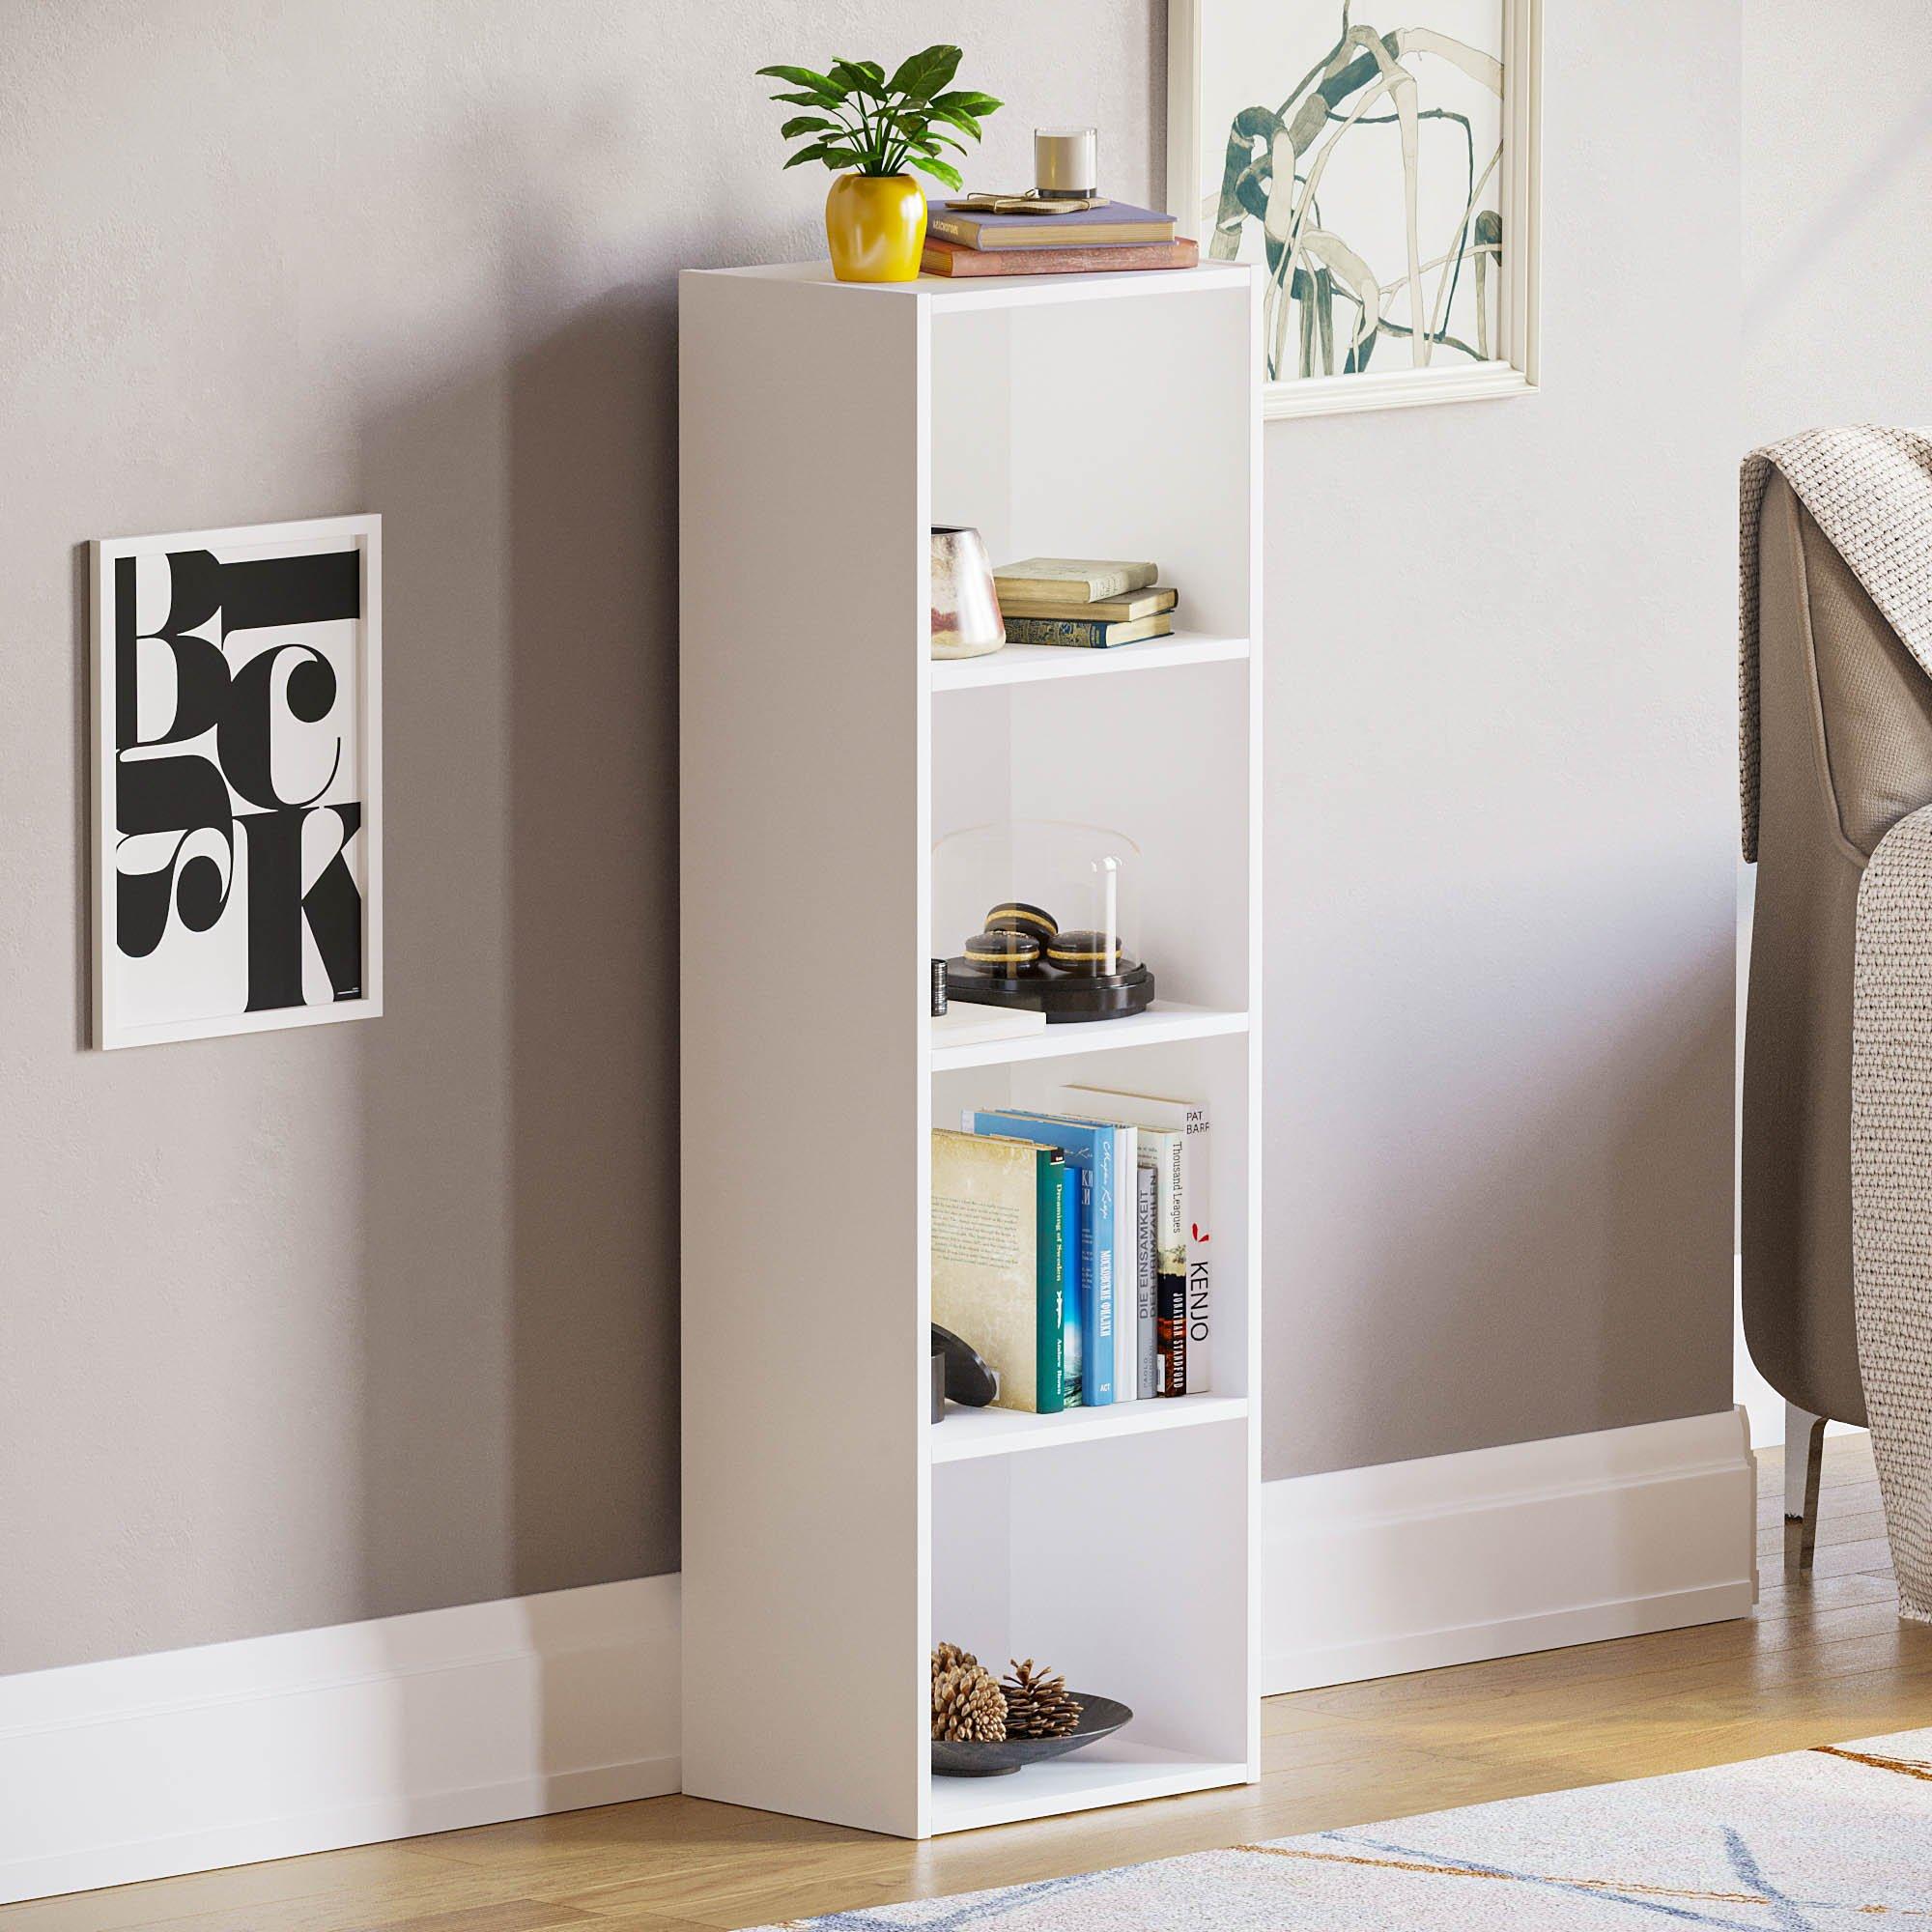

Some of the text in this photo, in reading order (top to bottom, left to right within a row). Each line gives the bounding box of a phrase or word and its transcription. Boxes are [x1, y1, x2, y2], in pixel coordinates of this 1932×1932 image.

[1186, 1111, 1203, 1122] PAT
[1171, 1141, 1182, 1234] Thousand Leagues
[1056, 1232, 1063, 1242] of
[1140, 1190, 1149, 1319] DIE EINSAMKEIT
[1173, 1293, 1183, 1388] JONATHAN STANDFORD
[1190, 1262, 1208, 1342] KENJO
